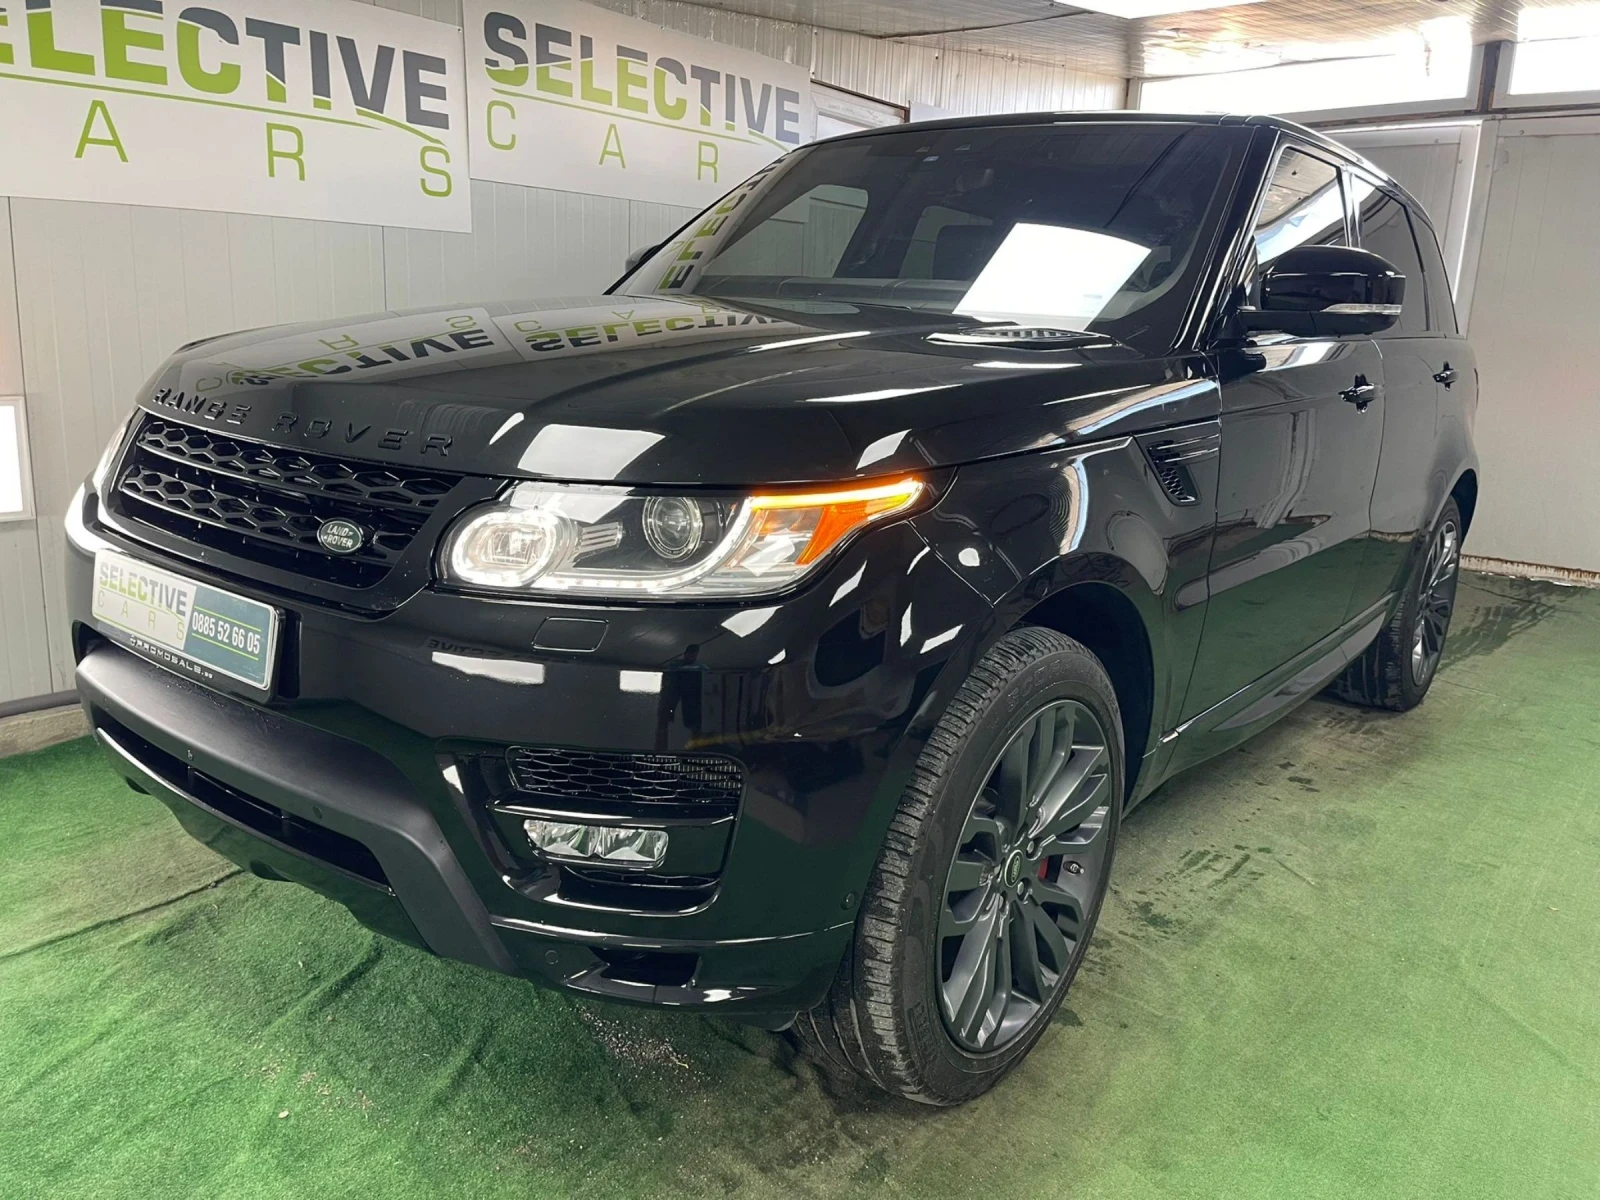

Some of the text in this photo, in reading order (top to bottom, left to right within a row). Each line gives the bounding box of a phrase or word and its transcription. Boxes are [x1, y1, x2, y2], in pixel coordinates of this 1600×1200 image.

[0, 0, 450, 130] LECTIVE
[483, 11, 800, 144] SELECTIVE
[74, 99, 453, 198] ARS
[486, 99, 719, 184] CAR
[152, 387, 453, 457] RANGE ROVER
[326, 524, 349, 537] LAND
[326, 534, 353, 548] ROVER
[100, 562, 187, 617] SELECTIVE
[191, 611, 260, 654] 0885 52 66 05
